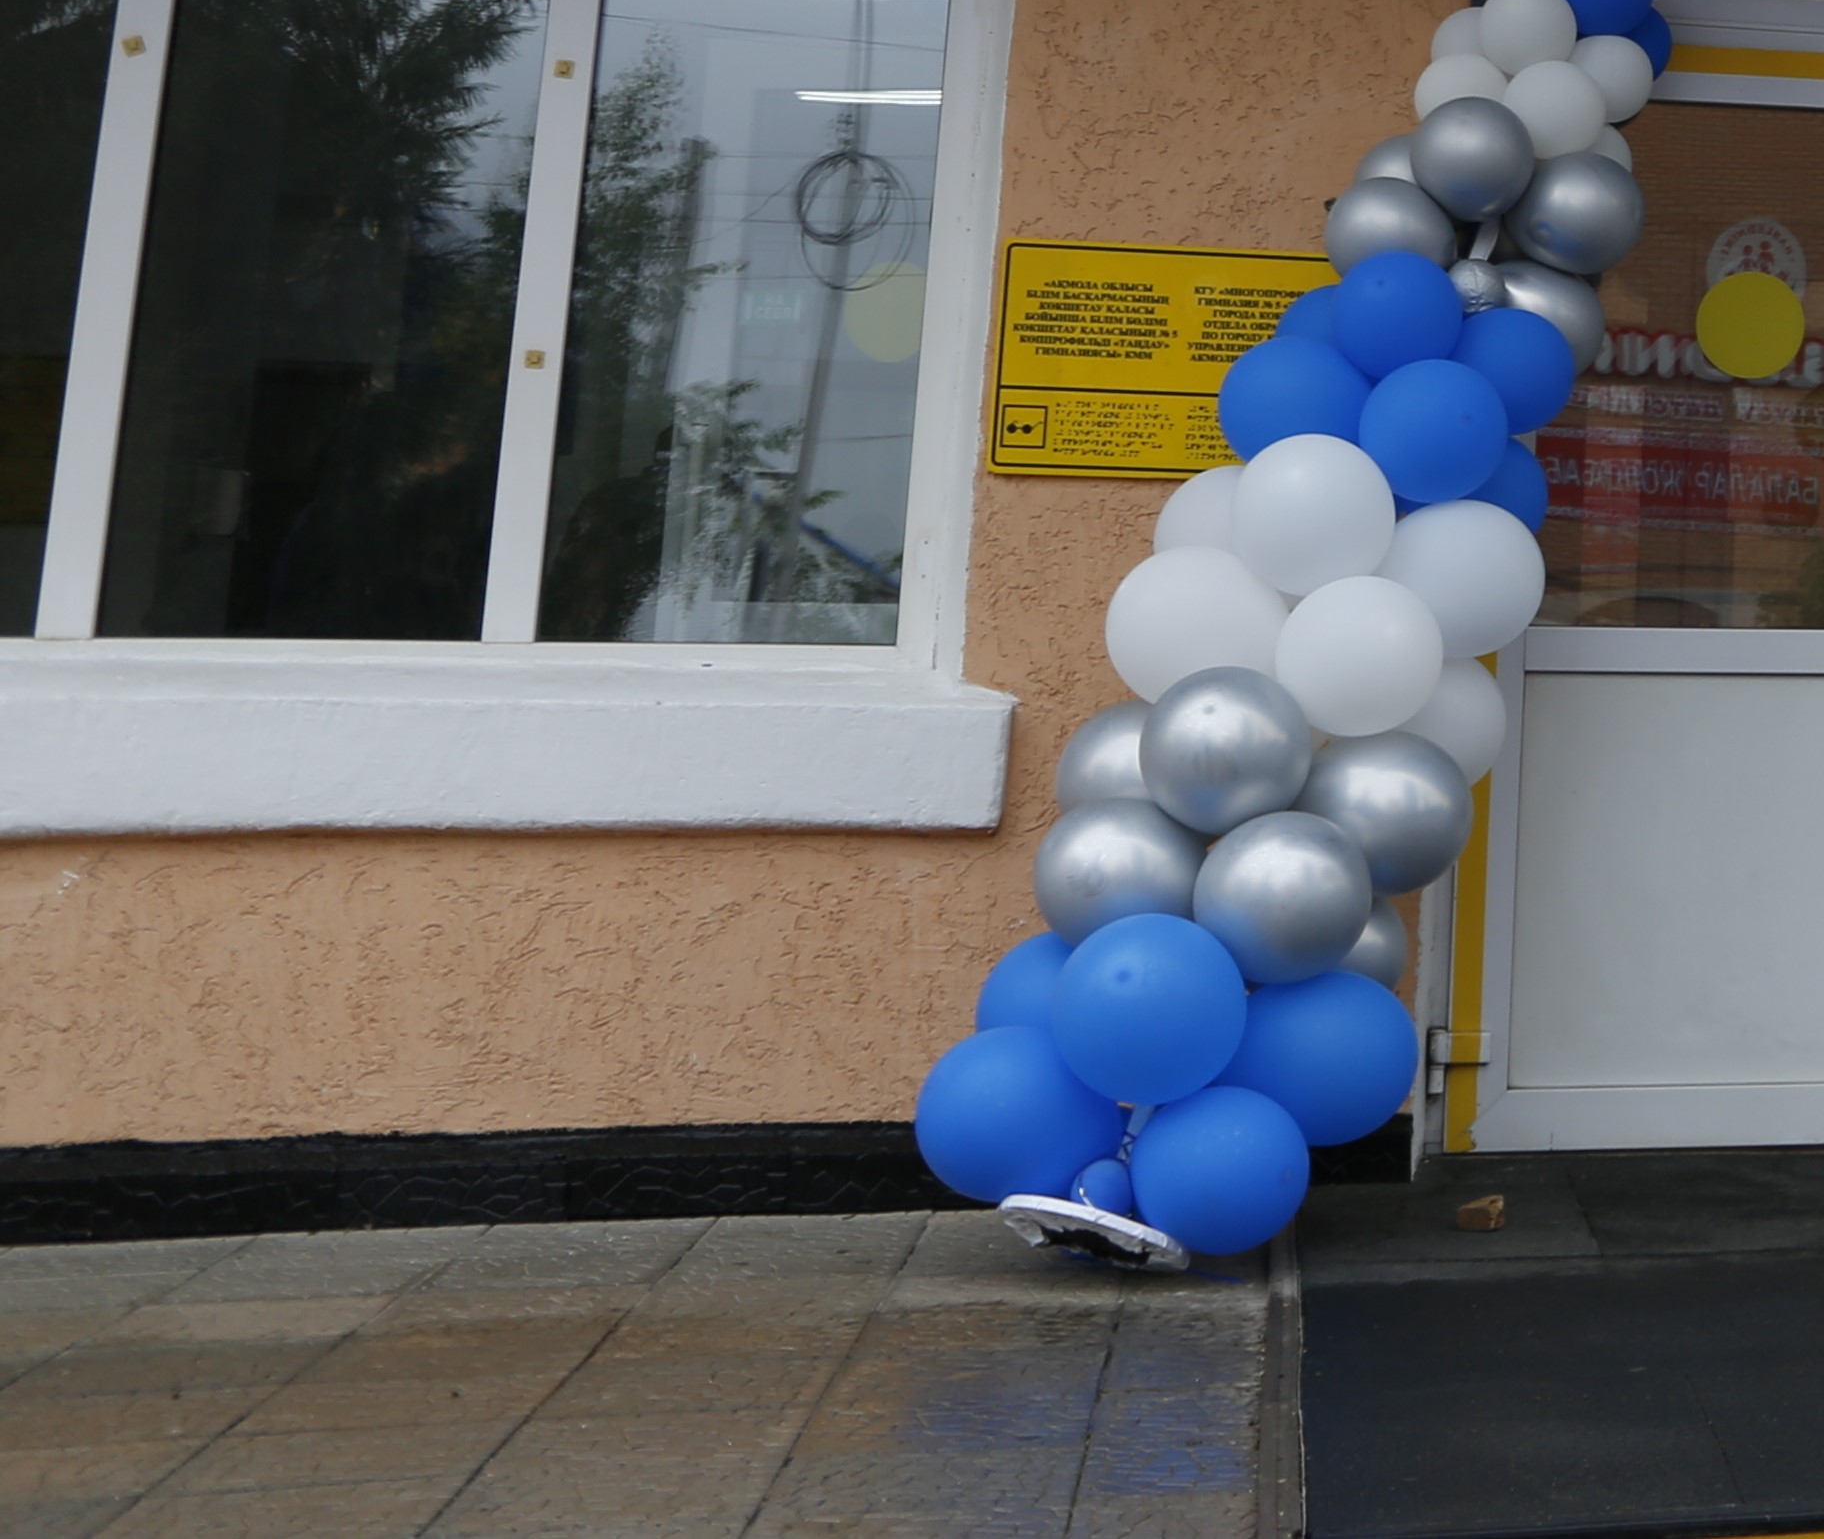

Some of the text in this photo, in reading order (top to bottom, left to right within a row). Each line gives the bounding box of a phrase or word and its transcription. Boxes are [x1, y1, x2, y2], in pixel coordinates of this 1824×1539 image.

[1102, 282, 1153, 292] ОБЛЫСЫ
[1194, 286, 1216, 295] КГУ
[1198, 297, 1259, 308] ГИМНАЗИЯ
[1213, 309, 1256, 319] ГОРОДА
[1203, 321, 1248, 330] ОТДЕЛА
[1202, 331, 1218, 340] ПО
[1221, 332, 1264, 342] ГОРОДУ
